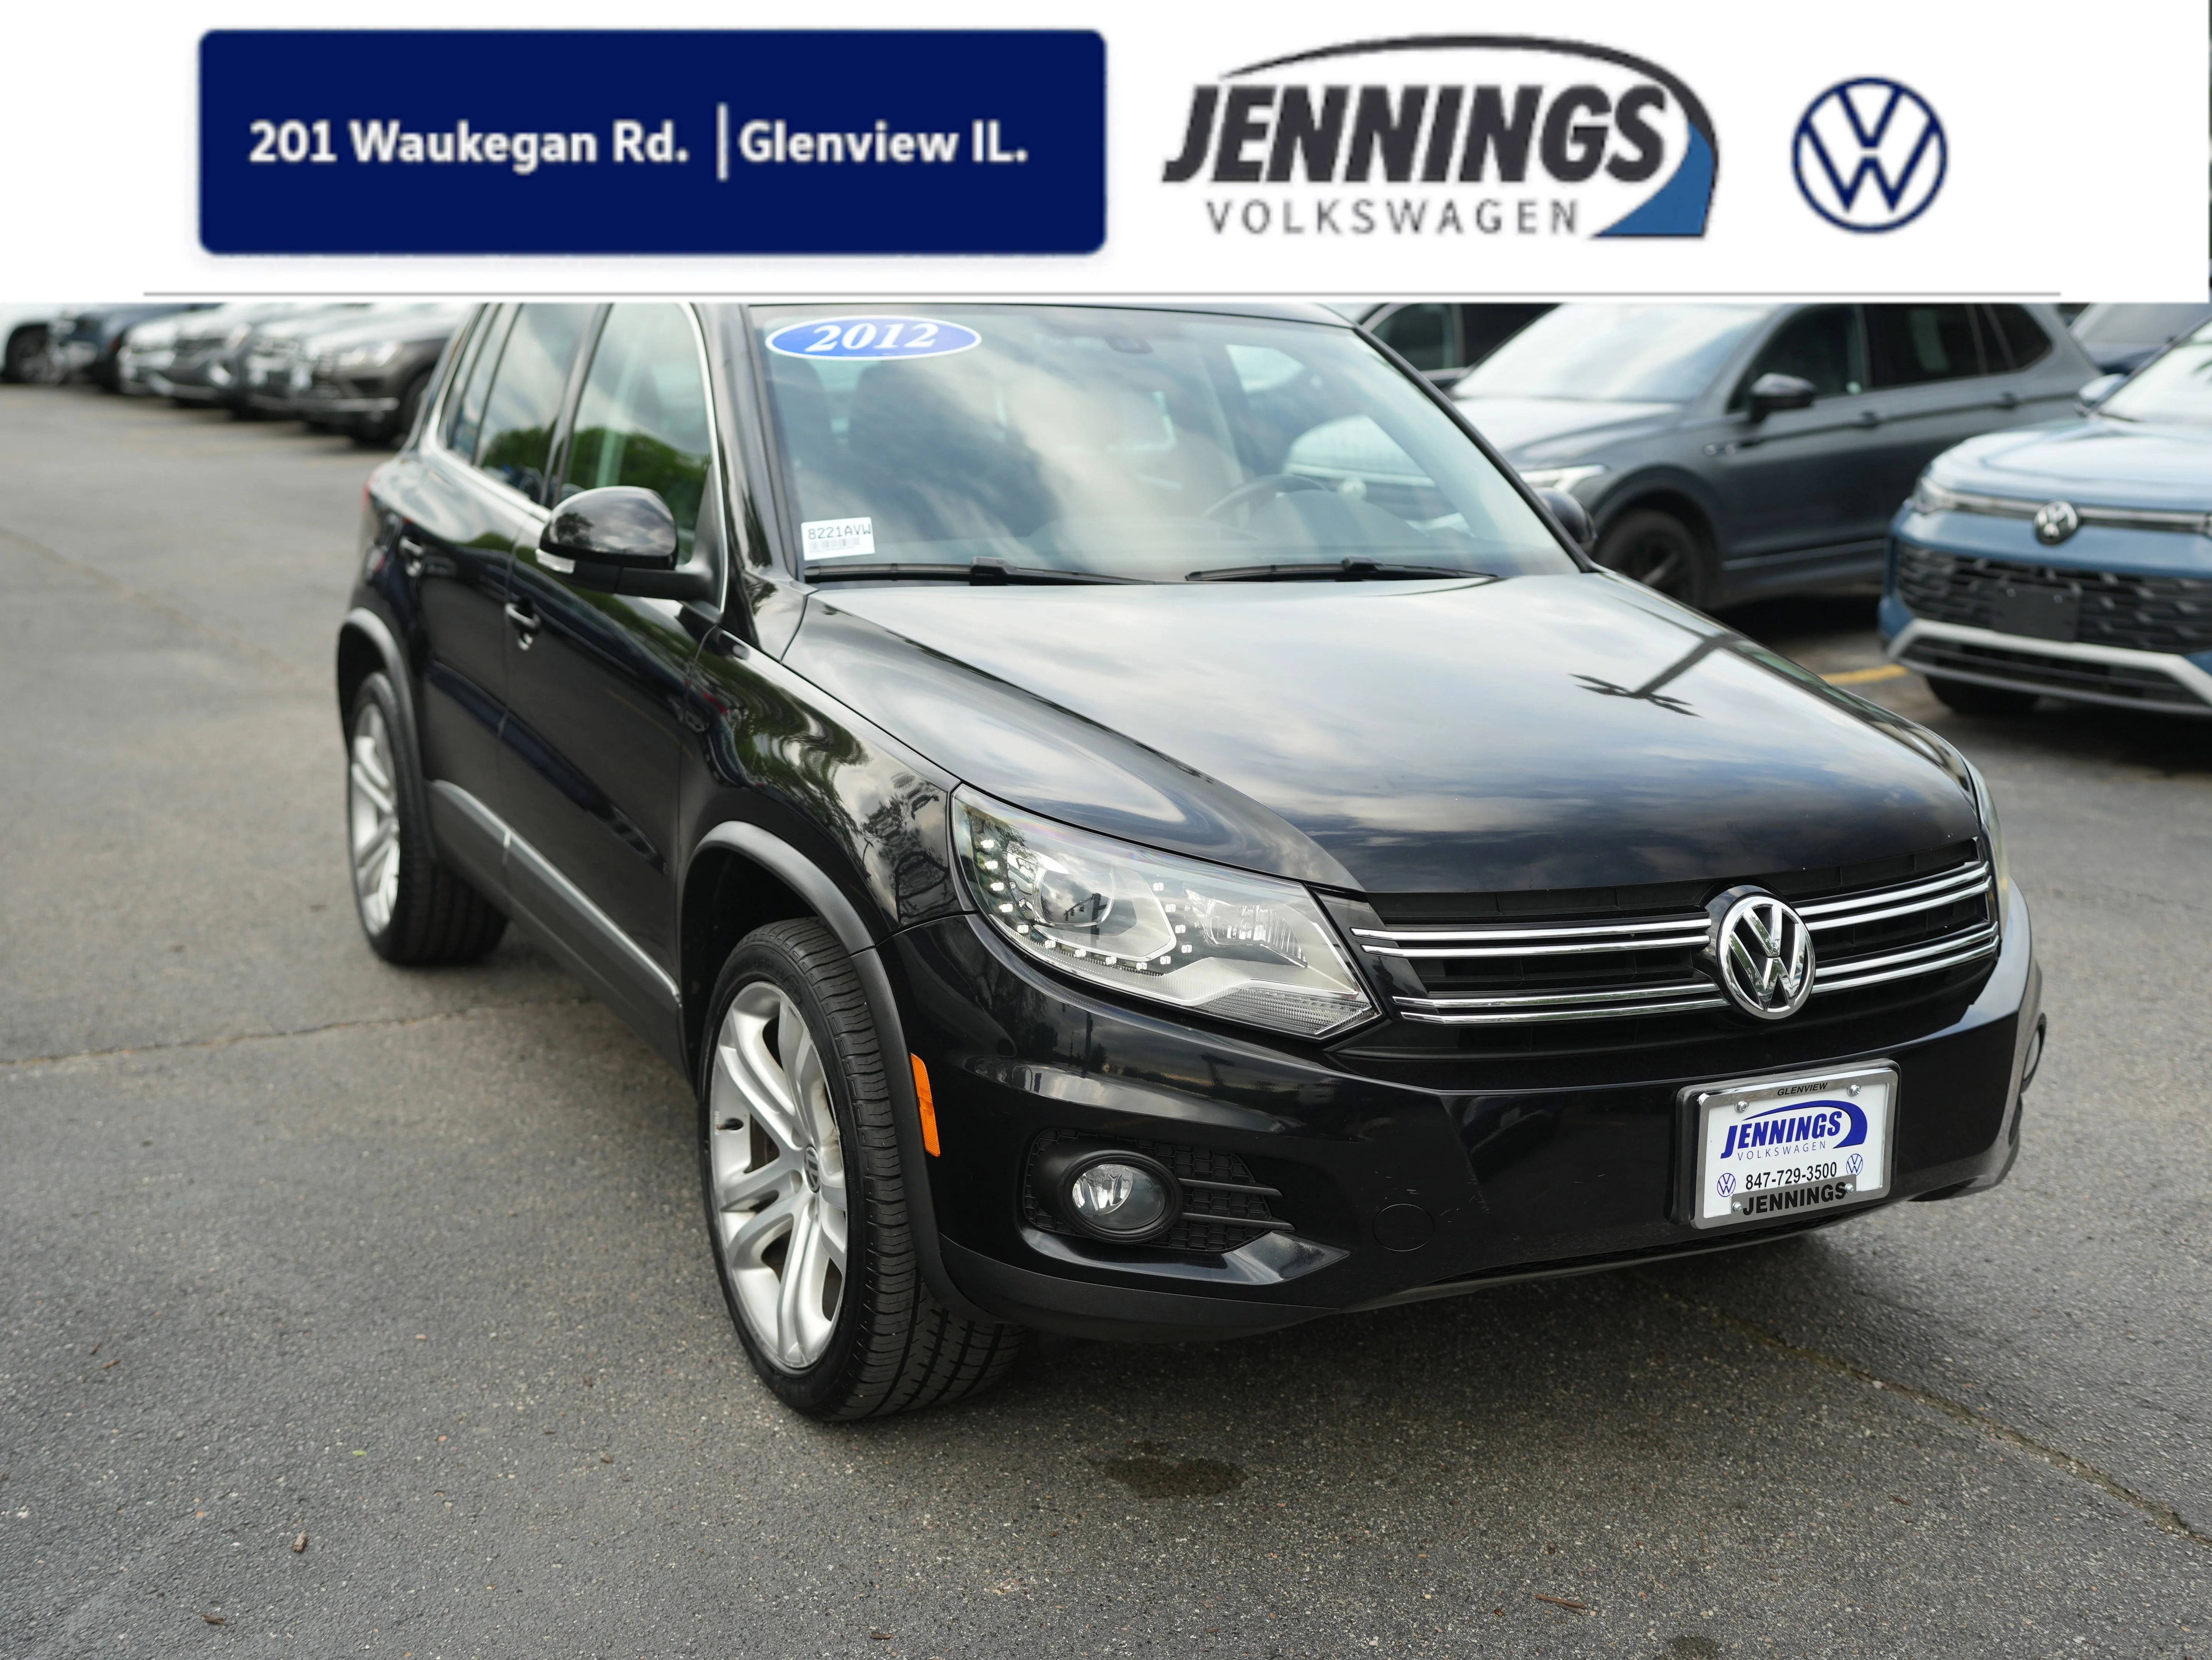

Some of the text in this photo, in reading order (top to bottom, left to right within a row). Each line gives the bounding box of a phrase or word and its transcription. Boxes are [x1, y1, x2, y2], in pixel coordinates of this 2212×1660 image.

[804, 323, 939, 352] 2012
[808, 523, 872, 540] 8221AVW
[1726, 899, 1809, 1013] VW
[1777, 1082, 1828, 1096] GLENVIEW
[1720, 1111, 1842, 1159] JENNINGS
[1737, 1140, 1826, 1161] VOLKSWAGEN
[1746, 1161, 1837, 1190] 847-729-3500
[1743, 1182, 1846, 1216] JENNINGS
